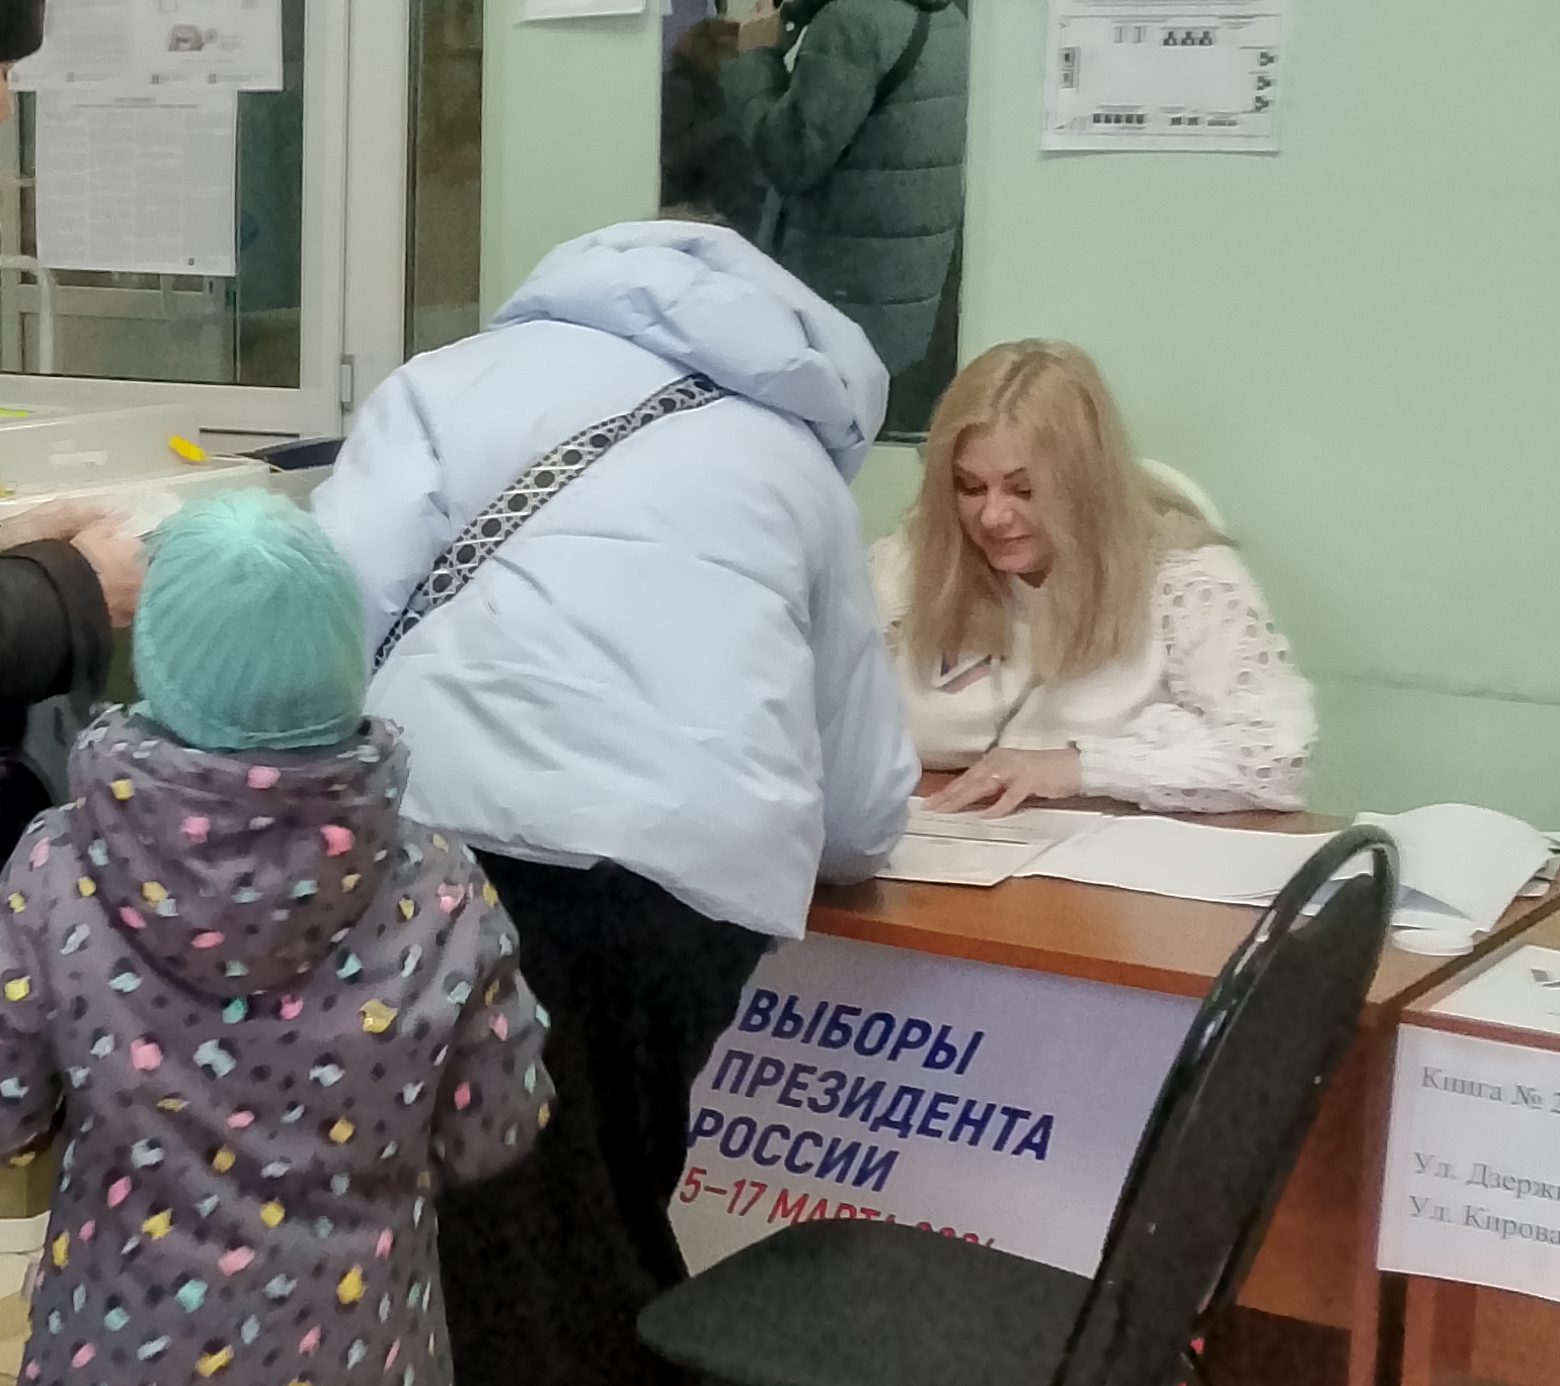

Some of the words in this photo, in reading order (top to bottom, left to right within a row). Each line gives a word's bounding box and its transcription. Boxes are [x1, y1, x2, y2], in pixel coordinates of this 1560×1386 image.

[737, 987, 985, 1075] ВЫБОРЫ
[711, 1049, 1055, 1161] ПРЕЗИДЕНТА
[1422, 1065, 1503, 1102] Книга
[686, 1107, 900, 1192] РОССИИ
[1465, 1162, 1560, 1202] Дзерж
[679, 1166, 768, 1216] 5–17
